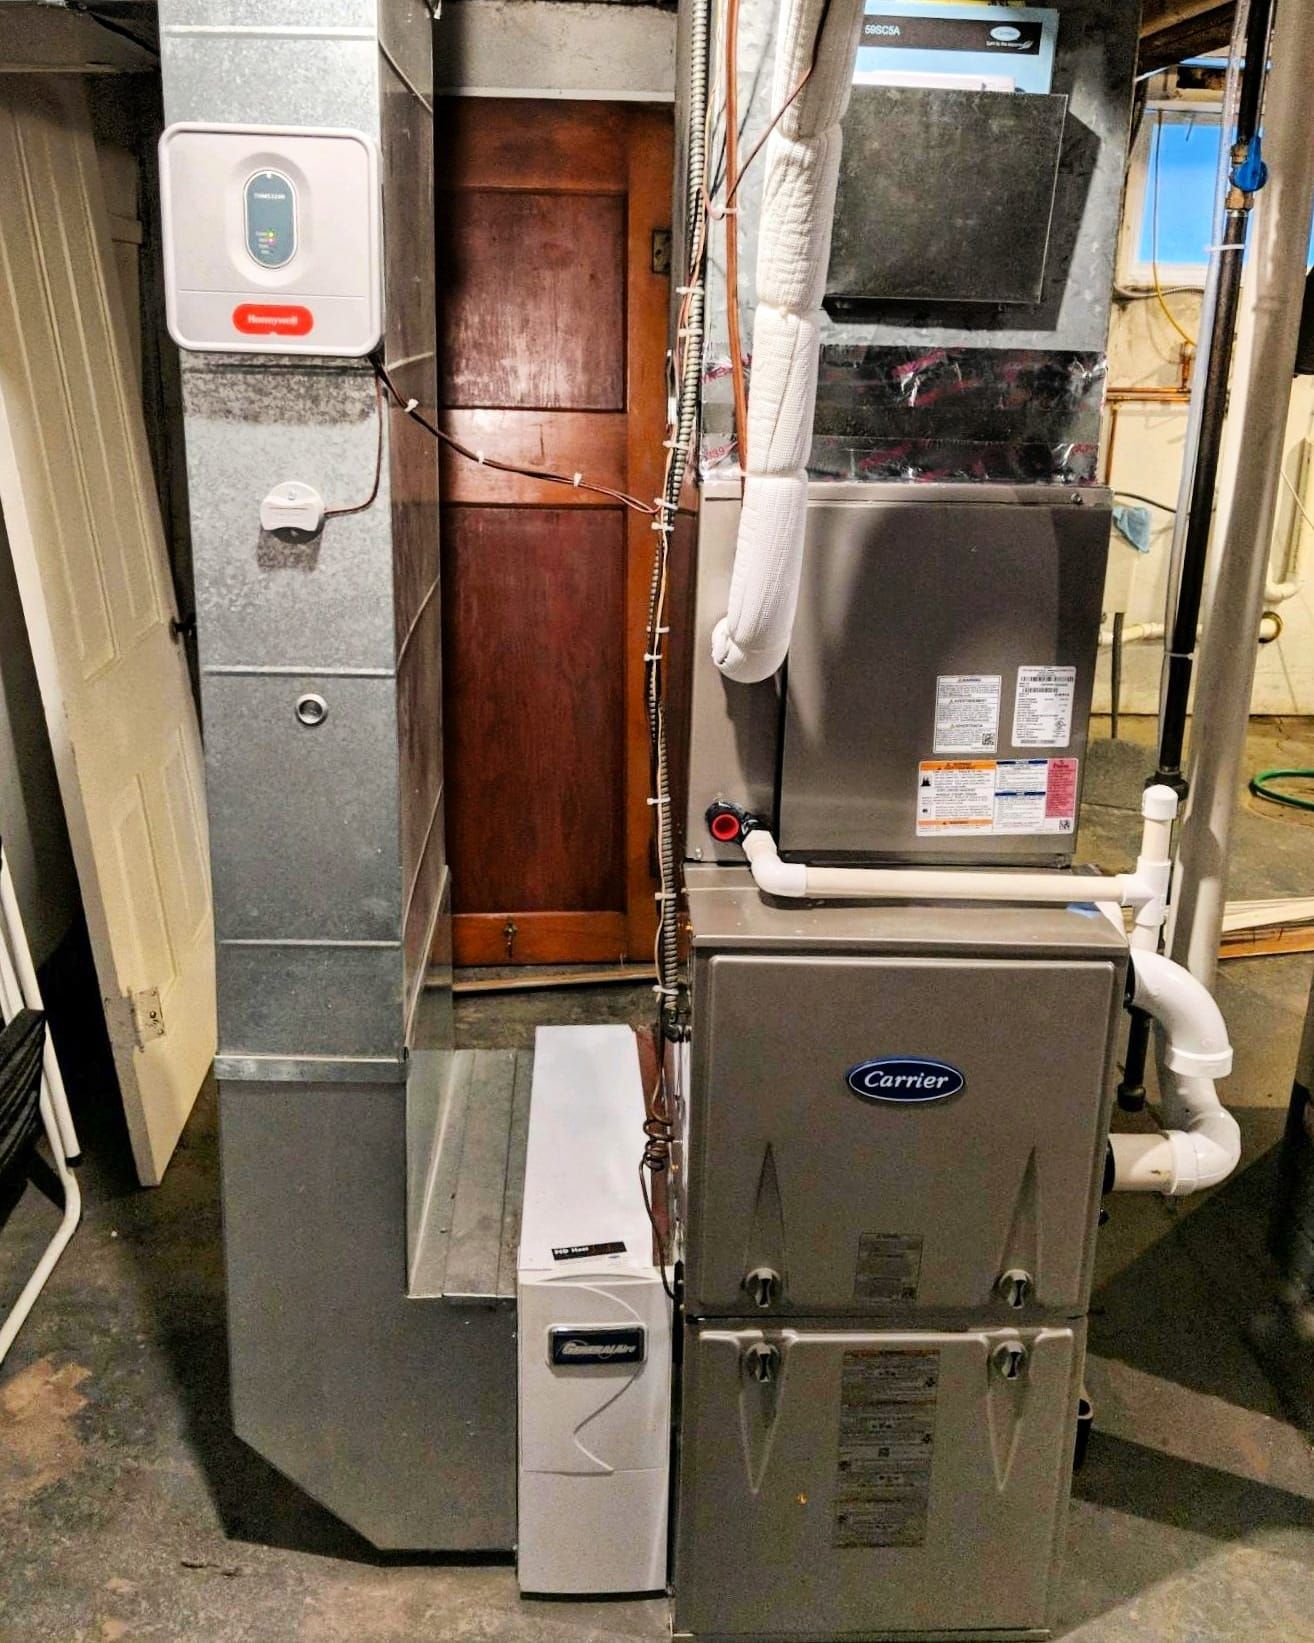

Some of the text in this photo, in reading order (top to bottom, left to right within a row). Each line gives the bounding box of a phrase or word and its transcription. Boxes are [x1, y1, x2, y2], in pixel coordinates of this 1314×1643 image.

[865, 25, 900, 36] 59SC5A
[248, 313, 298, 326] Honeywell
[864, 1070, 949, 1089] Carrier
